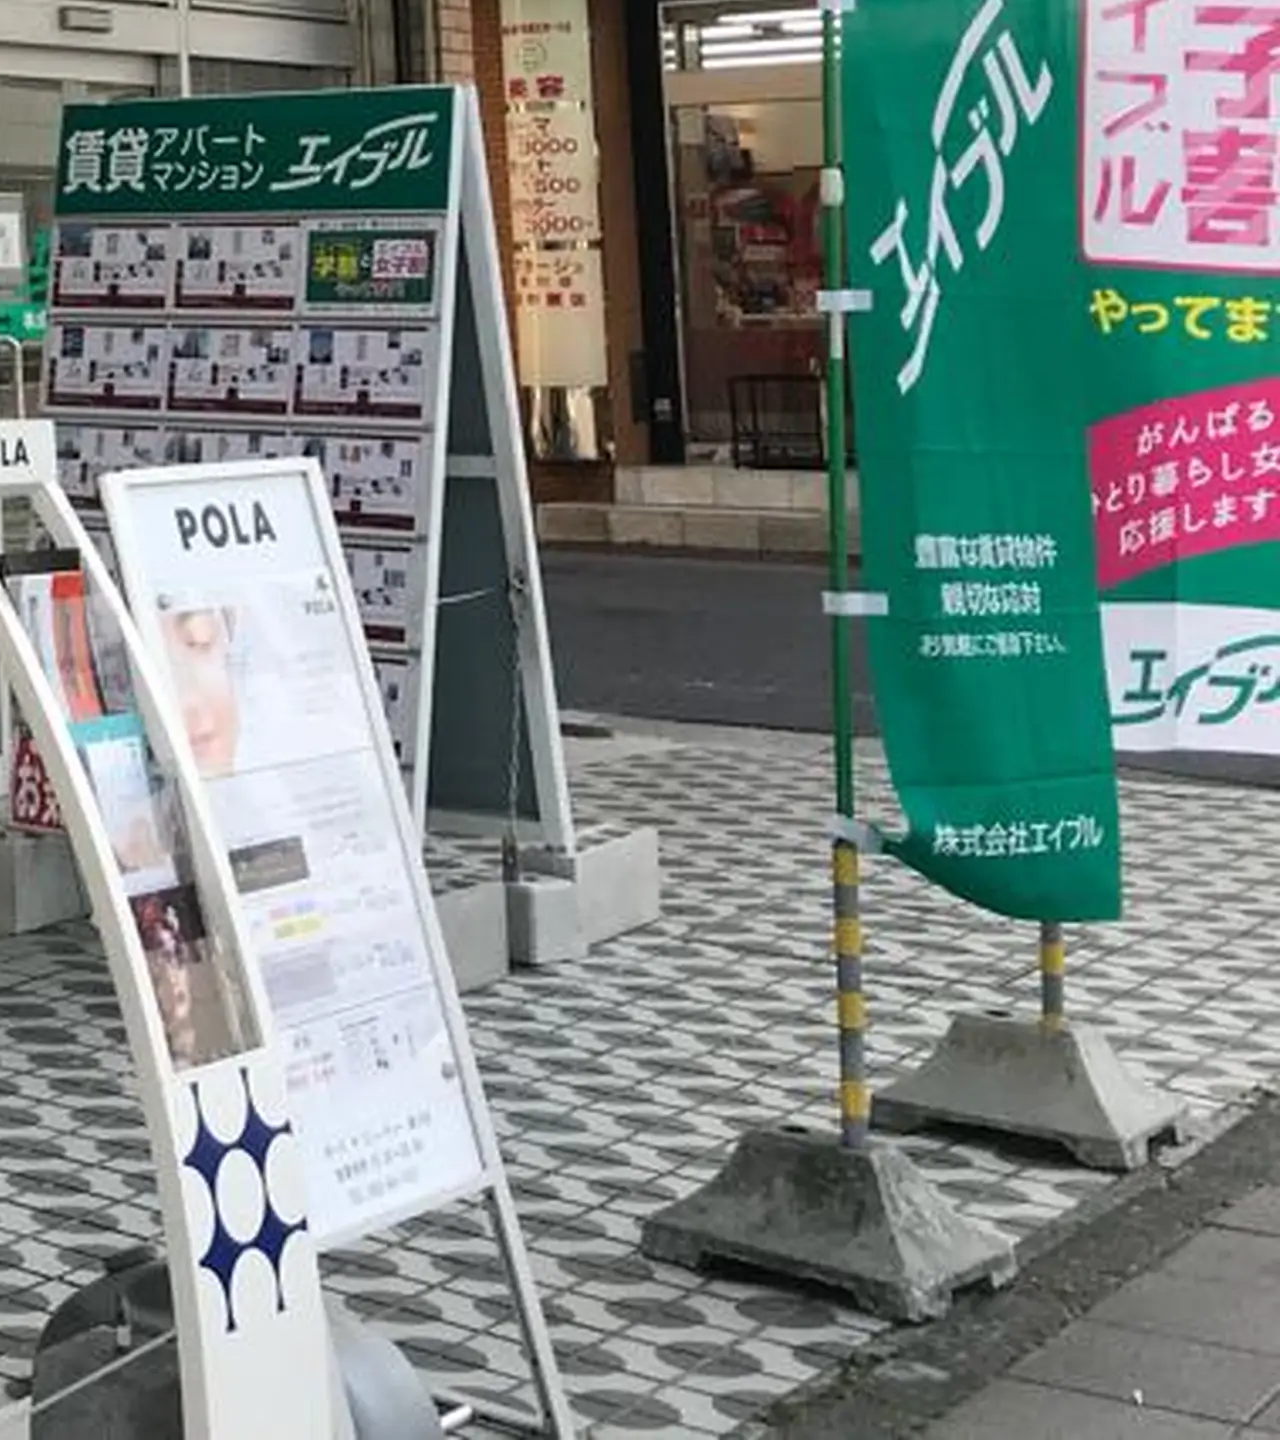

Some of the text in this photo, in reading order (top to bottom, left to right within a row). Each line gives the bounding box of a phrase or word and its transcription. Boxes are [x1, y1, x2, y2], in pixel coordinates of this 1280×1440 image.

[63, 112, 438, 194] 賃貸 エイブル
[152, 123, 265, 157] アパート
[151, 161, 265, 192] マンション
[1090, 289, 1280, 343] やってま
[1137, 399, 1274, 456] がんばる
[175, 501, 276, 550] POLA
[1111, 634, 1280, 725] エイブ
[933, 814, 1104, 857] 株式会社エイブル
